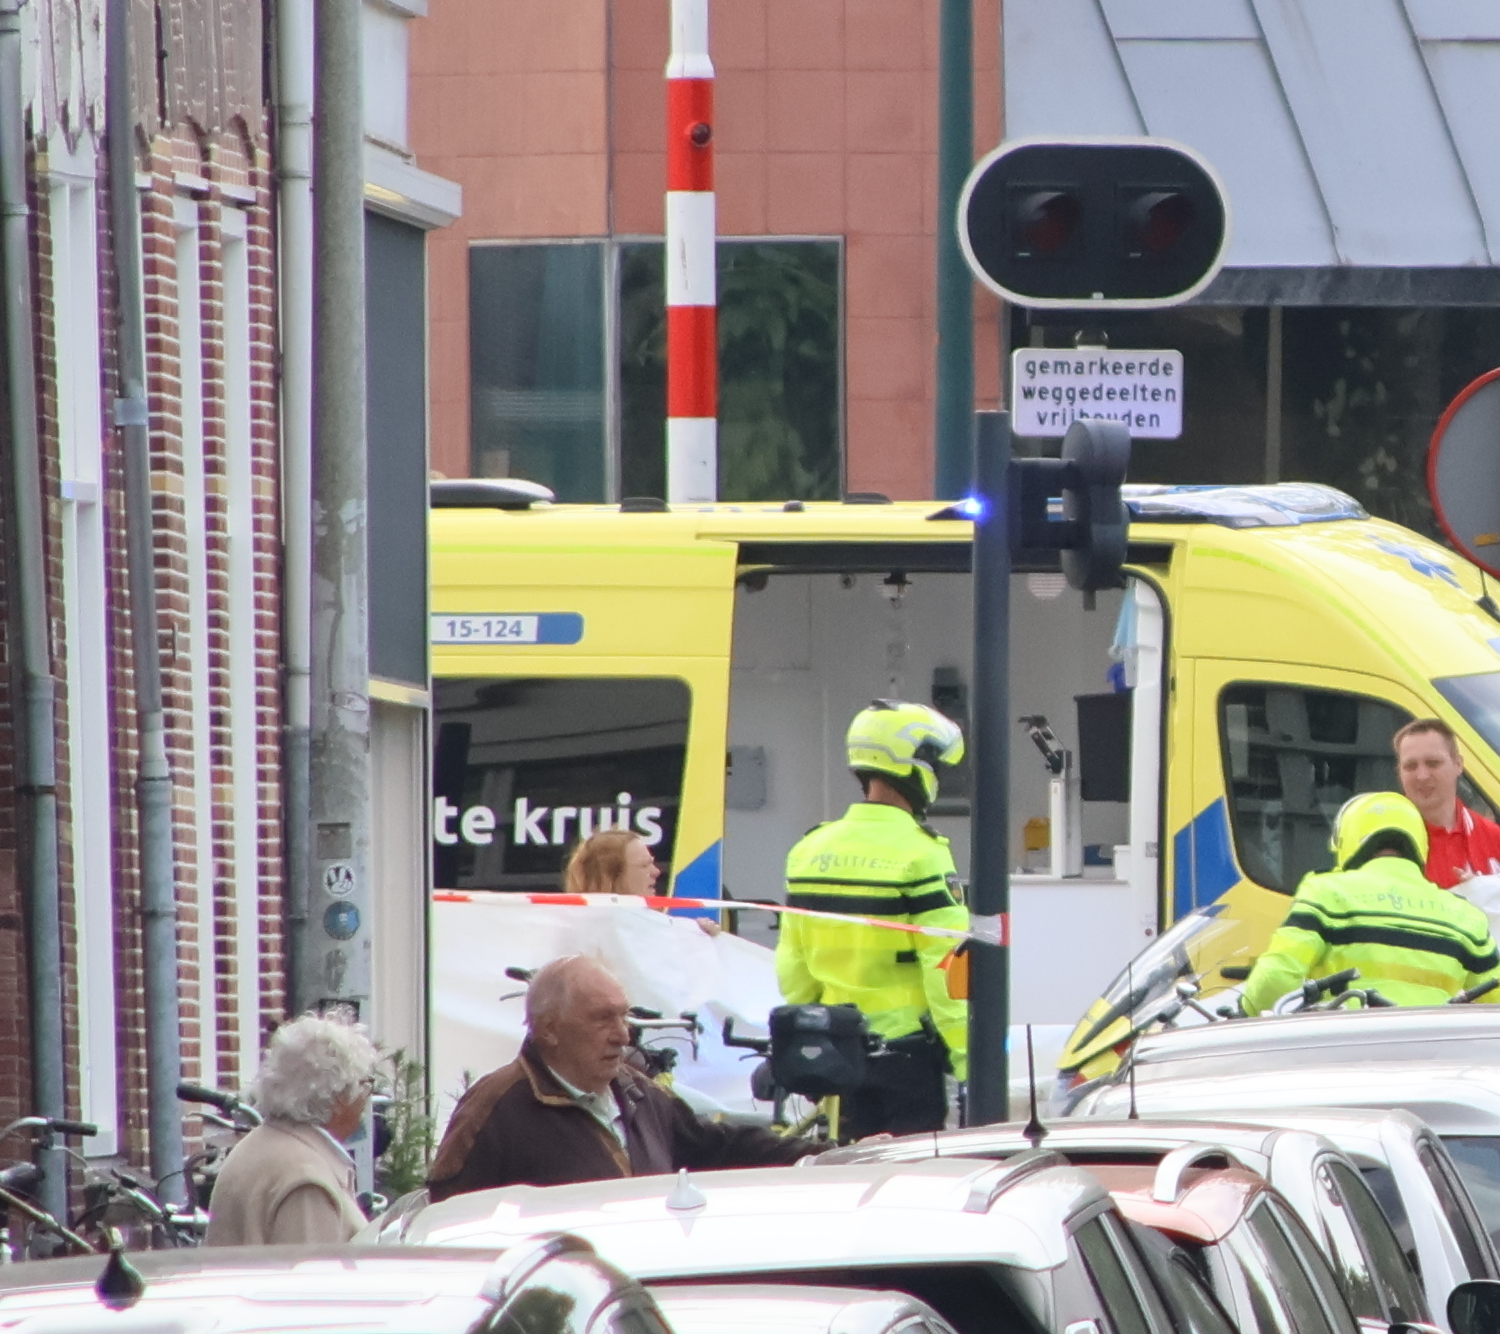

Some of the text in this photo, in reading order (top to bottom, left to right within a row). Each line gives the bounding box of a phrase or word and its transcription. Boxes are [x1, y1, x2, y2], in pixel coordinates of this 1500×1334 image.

[1025, 357, 1175, 379] gemarkeerde
[1021, 382, 1177, 406] weggedeelten
[446, 619, 523, 638] 15-124
